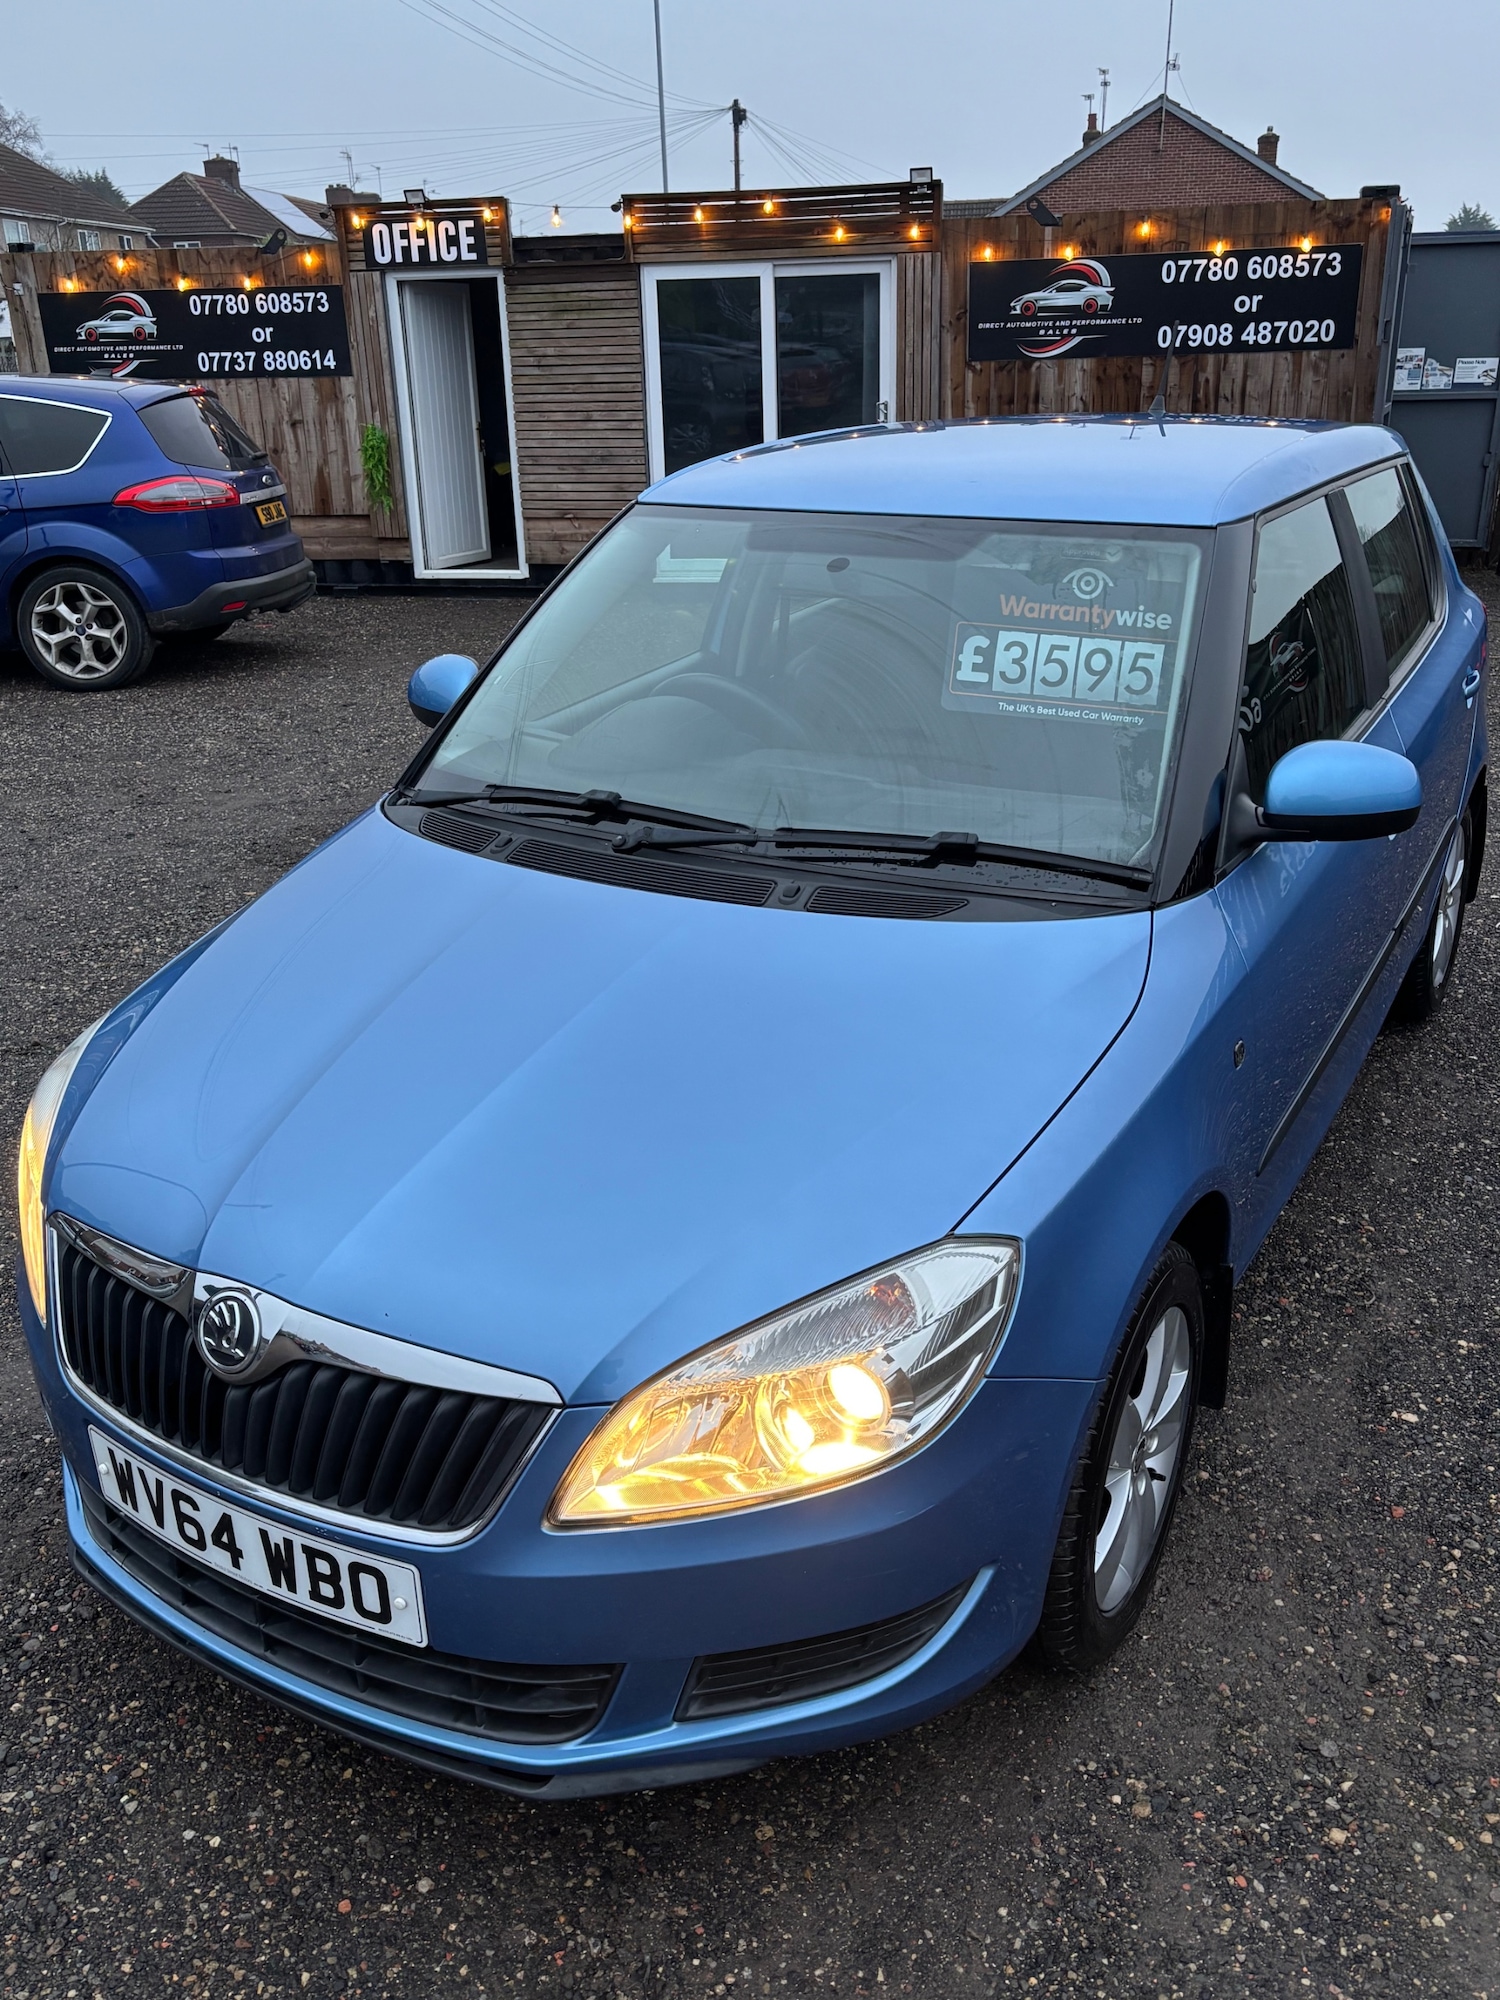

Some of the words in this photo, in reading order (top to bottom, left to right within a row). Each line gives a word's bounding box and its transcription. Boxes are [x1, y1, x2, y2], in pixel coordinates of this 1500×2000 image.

[371, 220, 477, 264] OFFICE
[1161, 257, 1239, 284] 07780
[1247, 251, 1342, 280] 608573
[189, 294, 249, 316] 07780
[255, 291, 329, 314] 608573
[1233, 294, 1263, 313] or
[252, 327, 274, 343] or
[1006, 320, 1054, 328] AUTOMOTIVE
[1072, 318, 1127, 326] PERFORMANCE
[1038, 328, 1078, 336] SALES
[1157, 323, 1233, 348] 07908
[1241, 319, 1335, 345] 487020
[197, 352, 256, 372] 07737
[263, 349, 337, 371] 880614
[1000, 594, 1173, 630] Warrantywise
[956, 635, 1156, 696] £3595
[998, 701, 1015, 712] The
[1016, 703, 1035, 714] UK's
[1037, 706, 1056, 716] Best
[1058, 707, 1080, 718] Used
[1082, 710, 1100, 720] Car
[1101, 712, 1145, 725] Warranty
[107, 1447, 244, 1571] WV64
[258, 1526, 393, 1626] WBO
